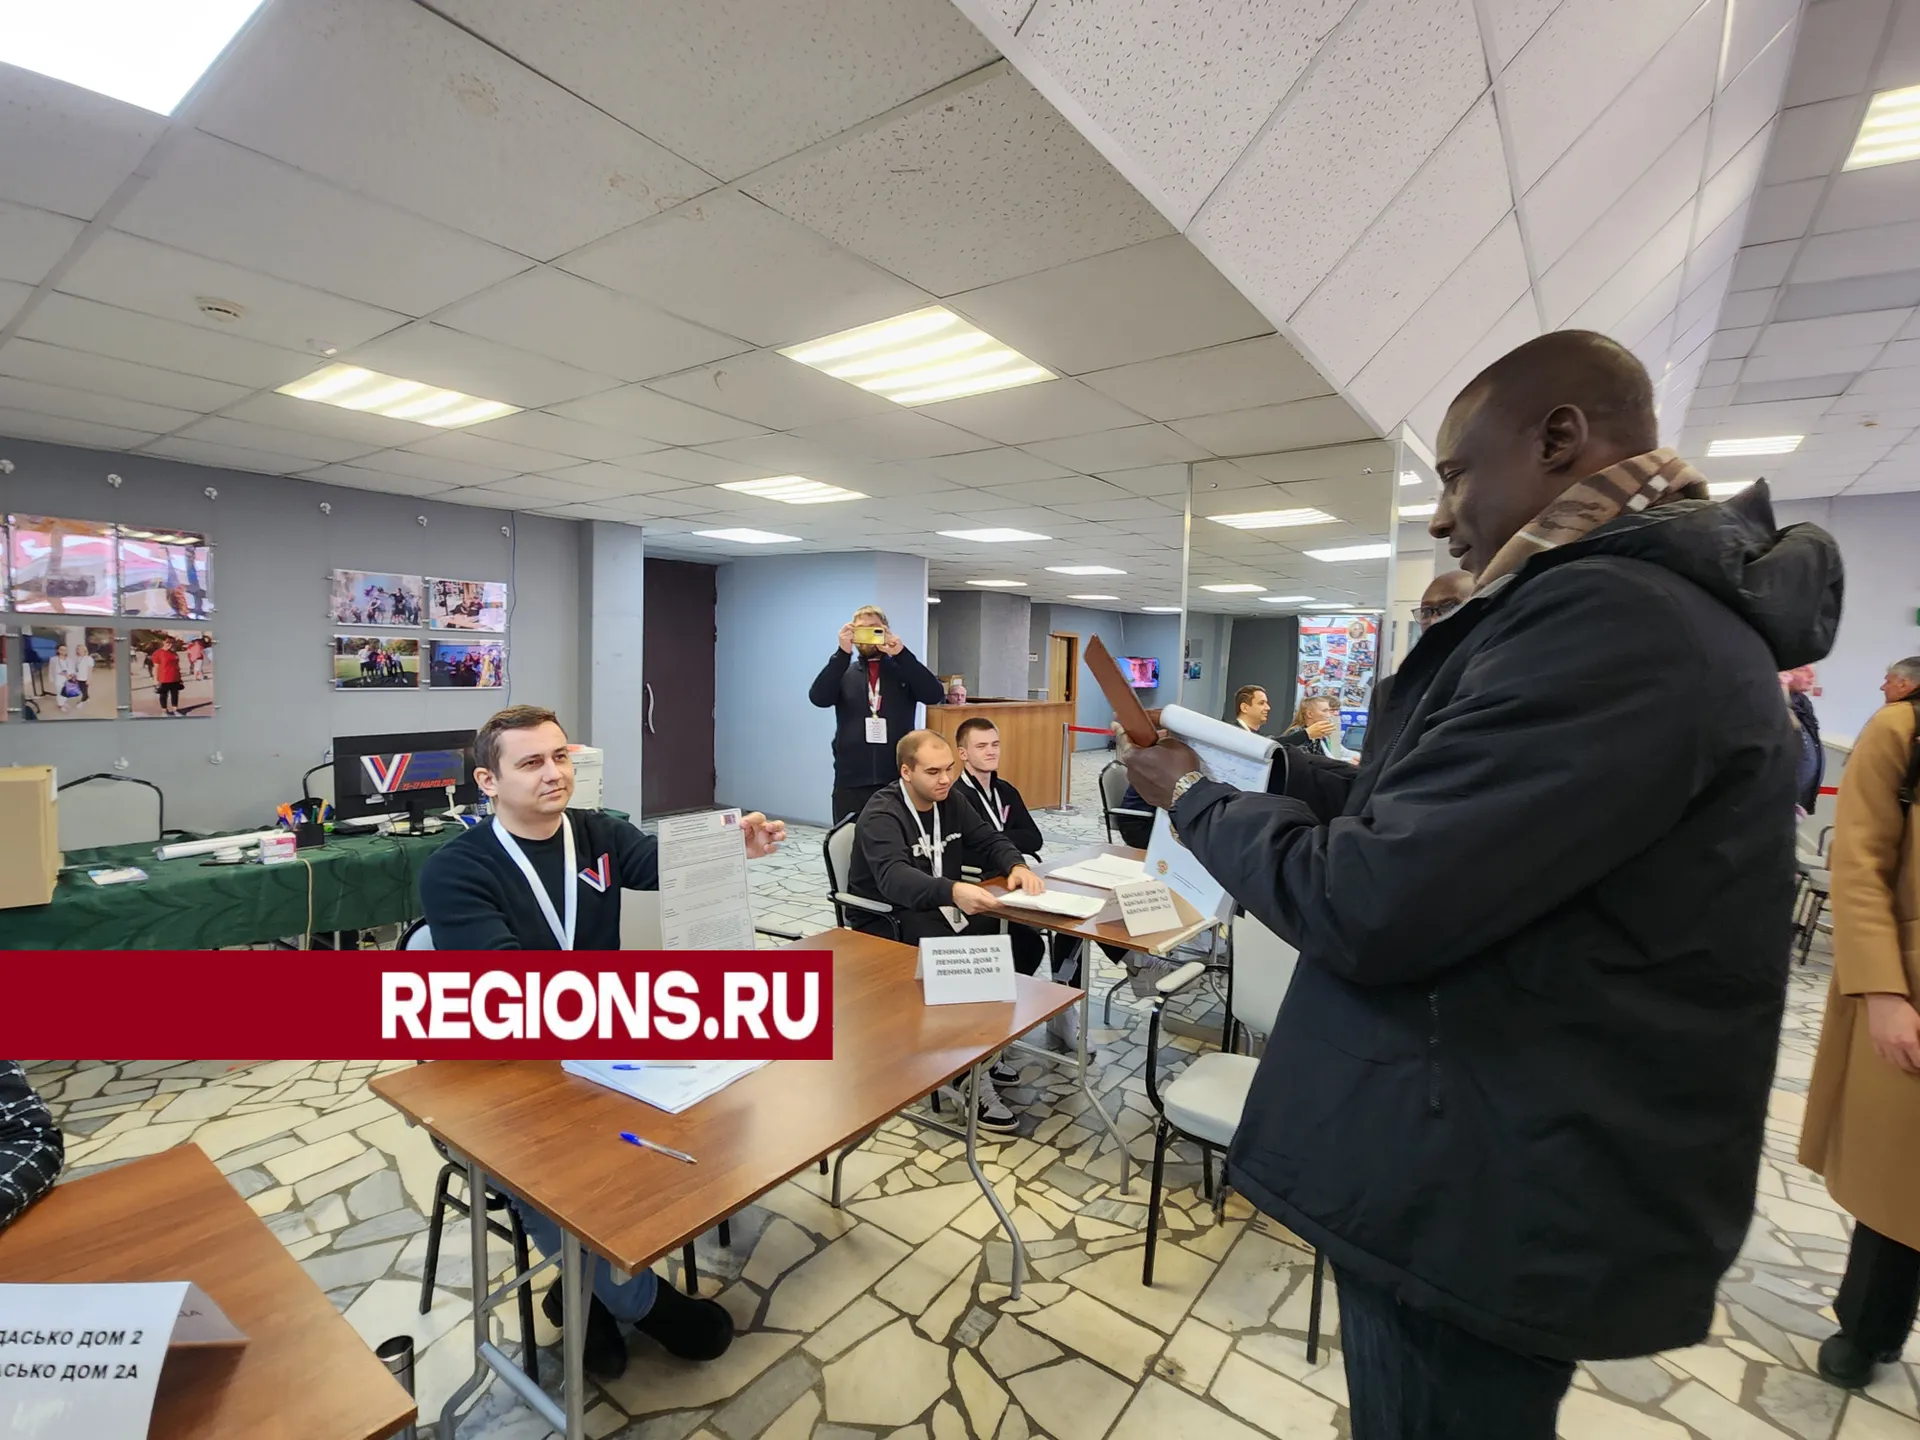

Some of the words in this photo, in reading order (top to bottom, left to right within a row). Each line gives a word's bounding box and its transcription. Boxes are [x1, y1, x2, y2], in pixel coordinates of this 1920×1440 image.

[932, 948, 967, 956] ЛЕНИНА
[969, 947, 988, 955] ДОМ
[935, 958, 971, 966] ЛЕНИНА
[972, 957, 992, 965] ДОМ
[936, 968, 972, 976] ЛЕНИНА
[974, 967, 993, 975] ДОМ
[77, 1330, 126, 1348] ДОМ
[130, 1330, 143, 1345] 2
[0, 1363, 56, 1379] СЬКО
[60, 1364, 108, 1382] ДОМ
[113, 1364, 138, 1379] 2А
